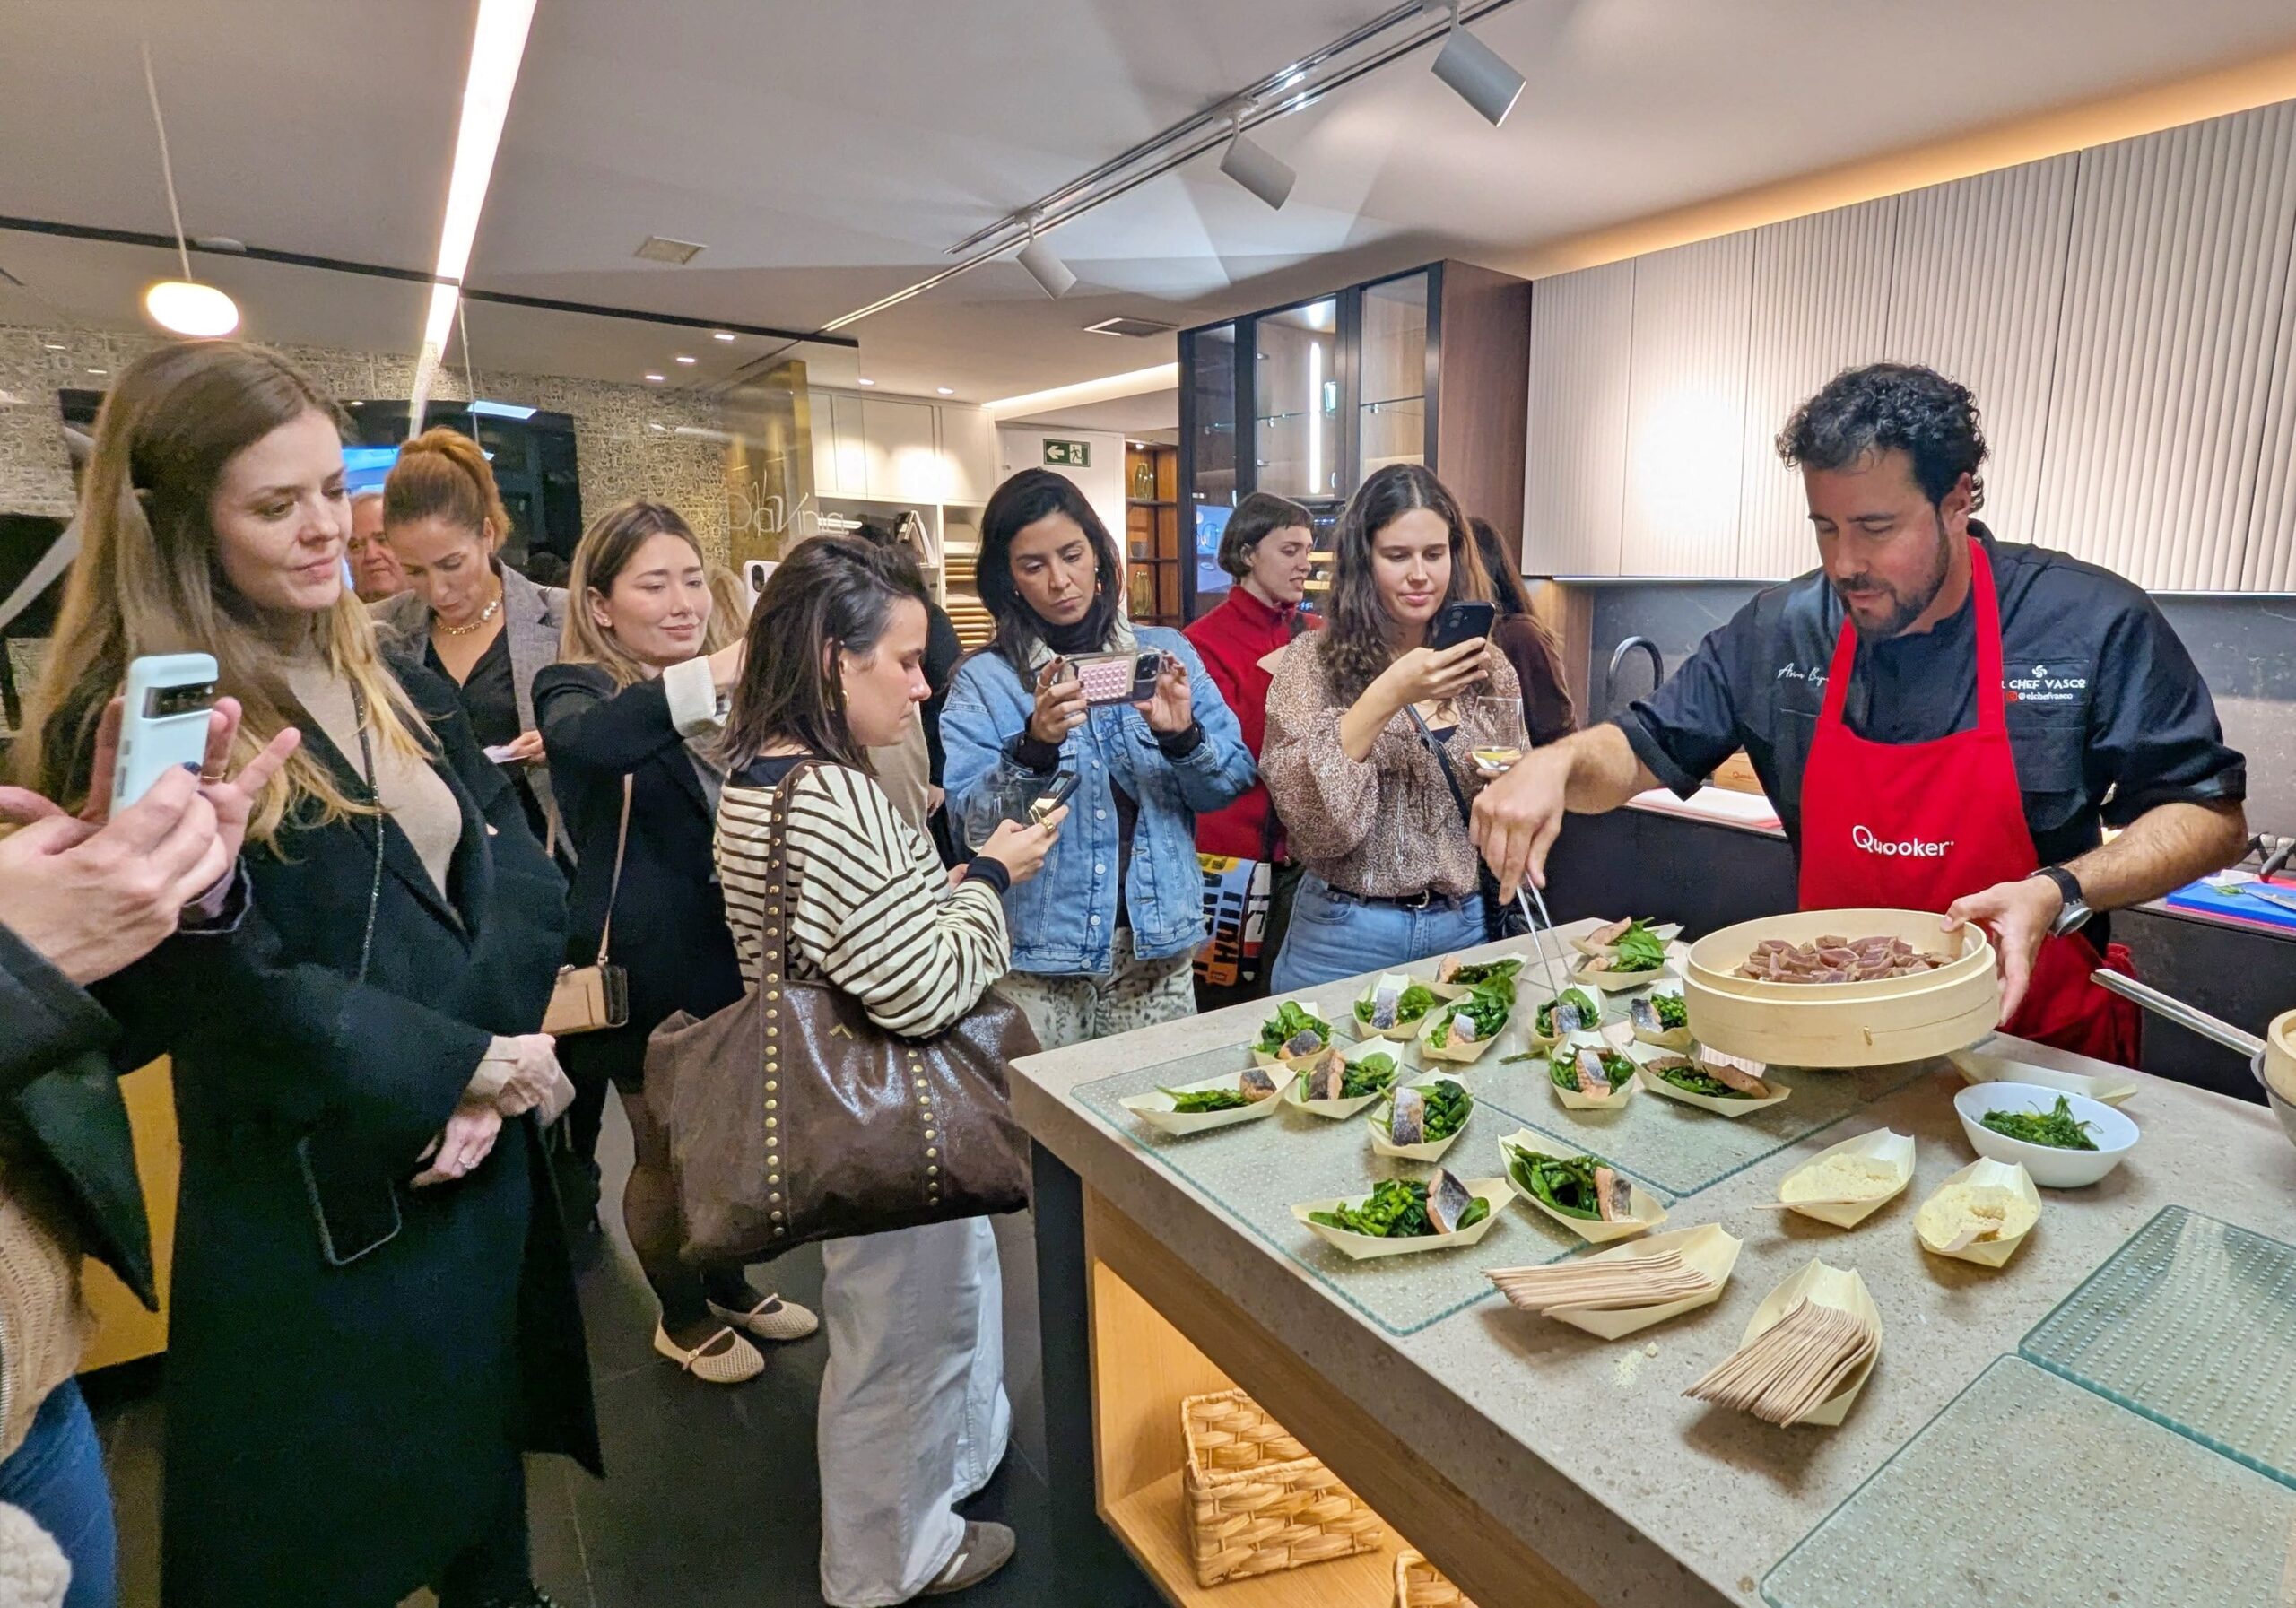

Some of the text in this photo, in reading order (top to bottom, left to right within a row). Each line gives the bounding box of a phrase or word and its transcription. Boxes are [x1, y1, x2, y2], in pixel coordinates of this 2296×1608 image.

[2009, 679, 2040, 690] CHEF
[2045, 679, 2086, 689] VASCO
[2018, 692, 2073, 700] @elchefvasco
[1853, 825, 1950, 856] Quooker
